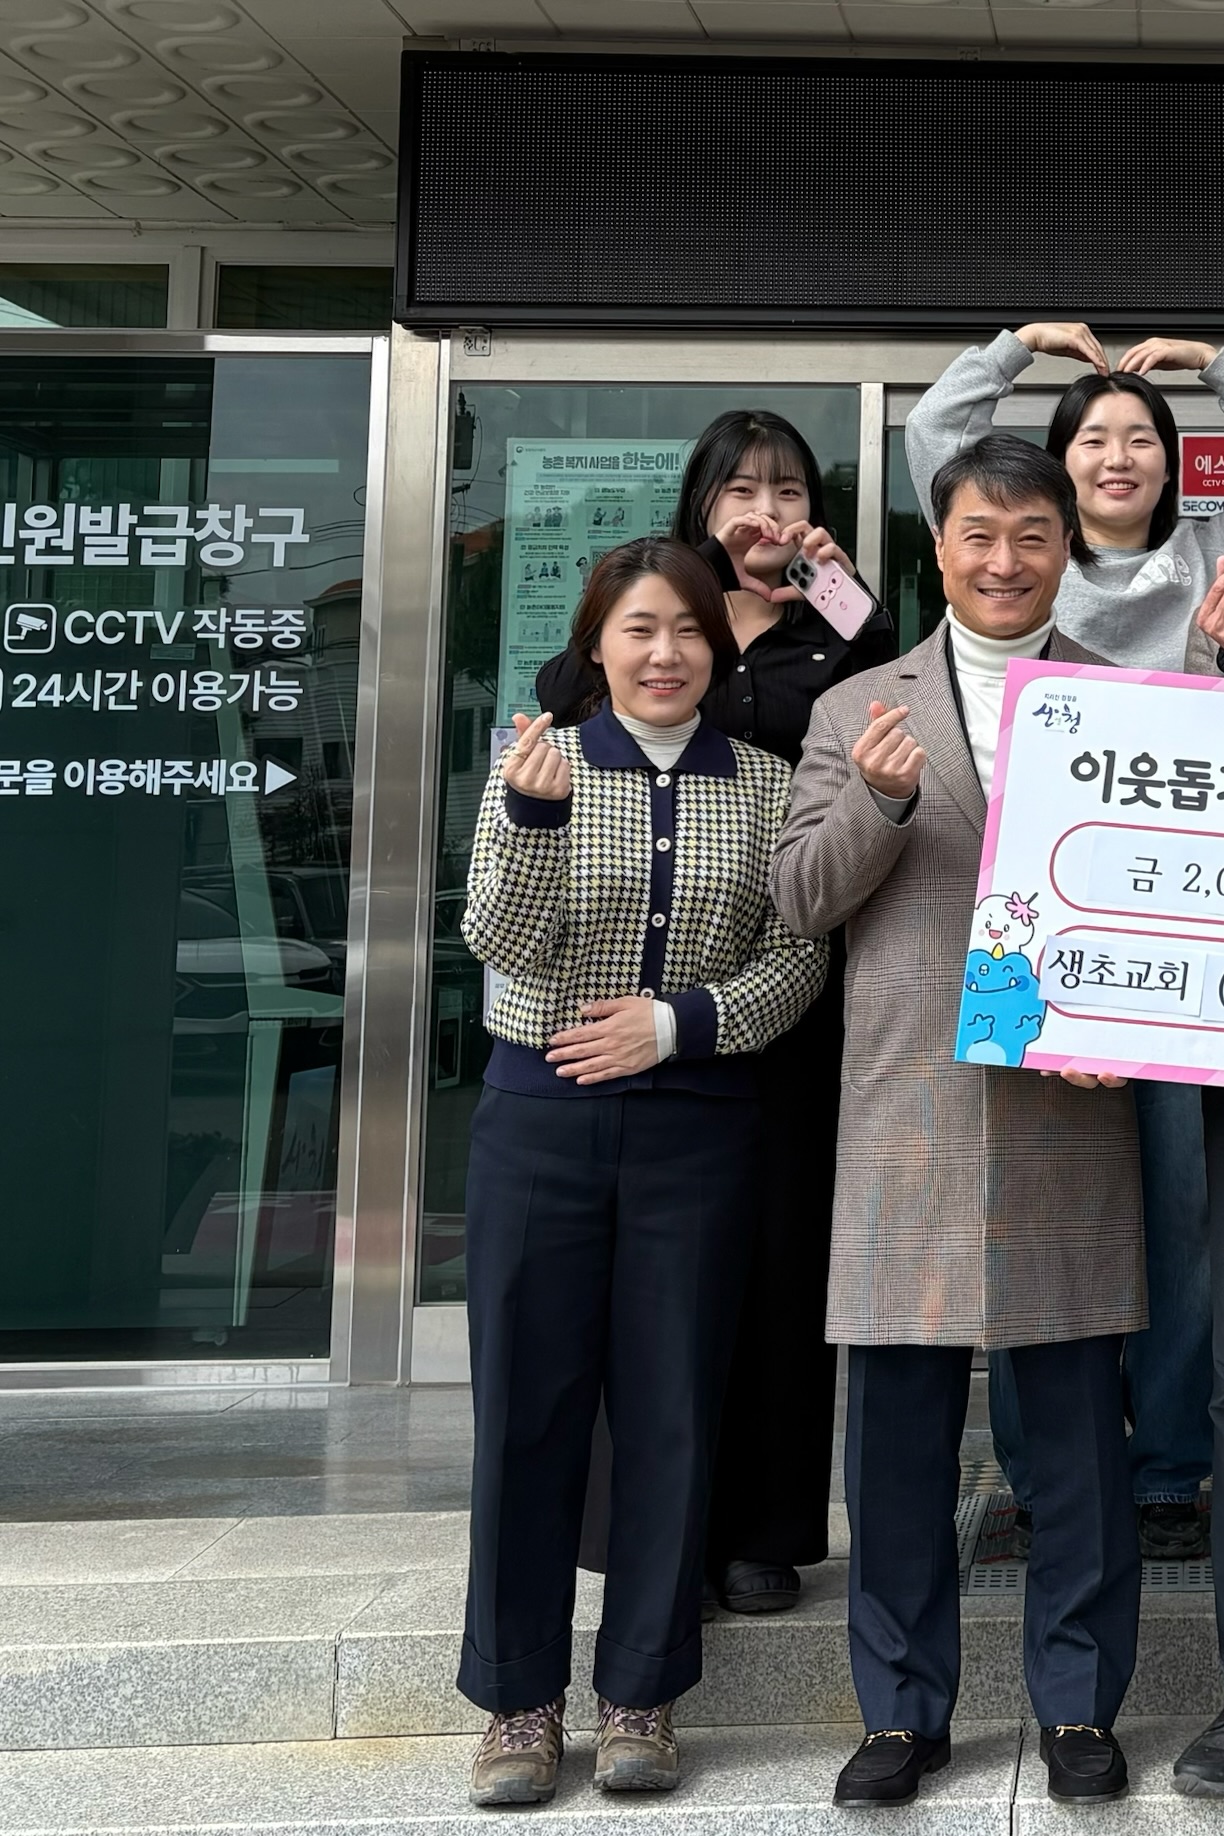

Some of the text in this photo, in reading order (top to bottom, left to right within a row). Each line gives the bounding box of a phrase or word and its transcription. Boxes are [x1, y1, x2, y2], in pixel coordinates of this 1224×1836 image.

[622, 451, 680, 471] 한눈에!
[63, 607, 307, 649] CCTV 작동중
[11, 669, 303, 712] 24시간 이용가능
[63, 757, 260, 796] 이용해주세요
[1126, 856, 1163, 894] 금
[1047, 948, 1190, 1001] 생초교회
